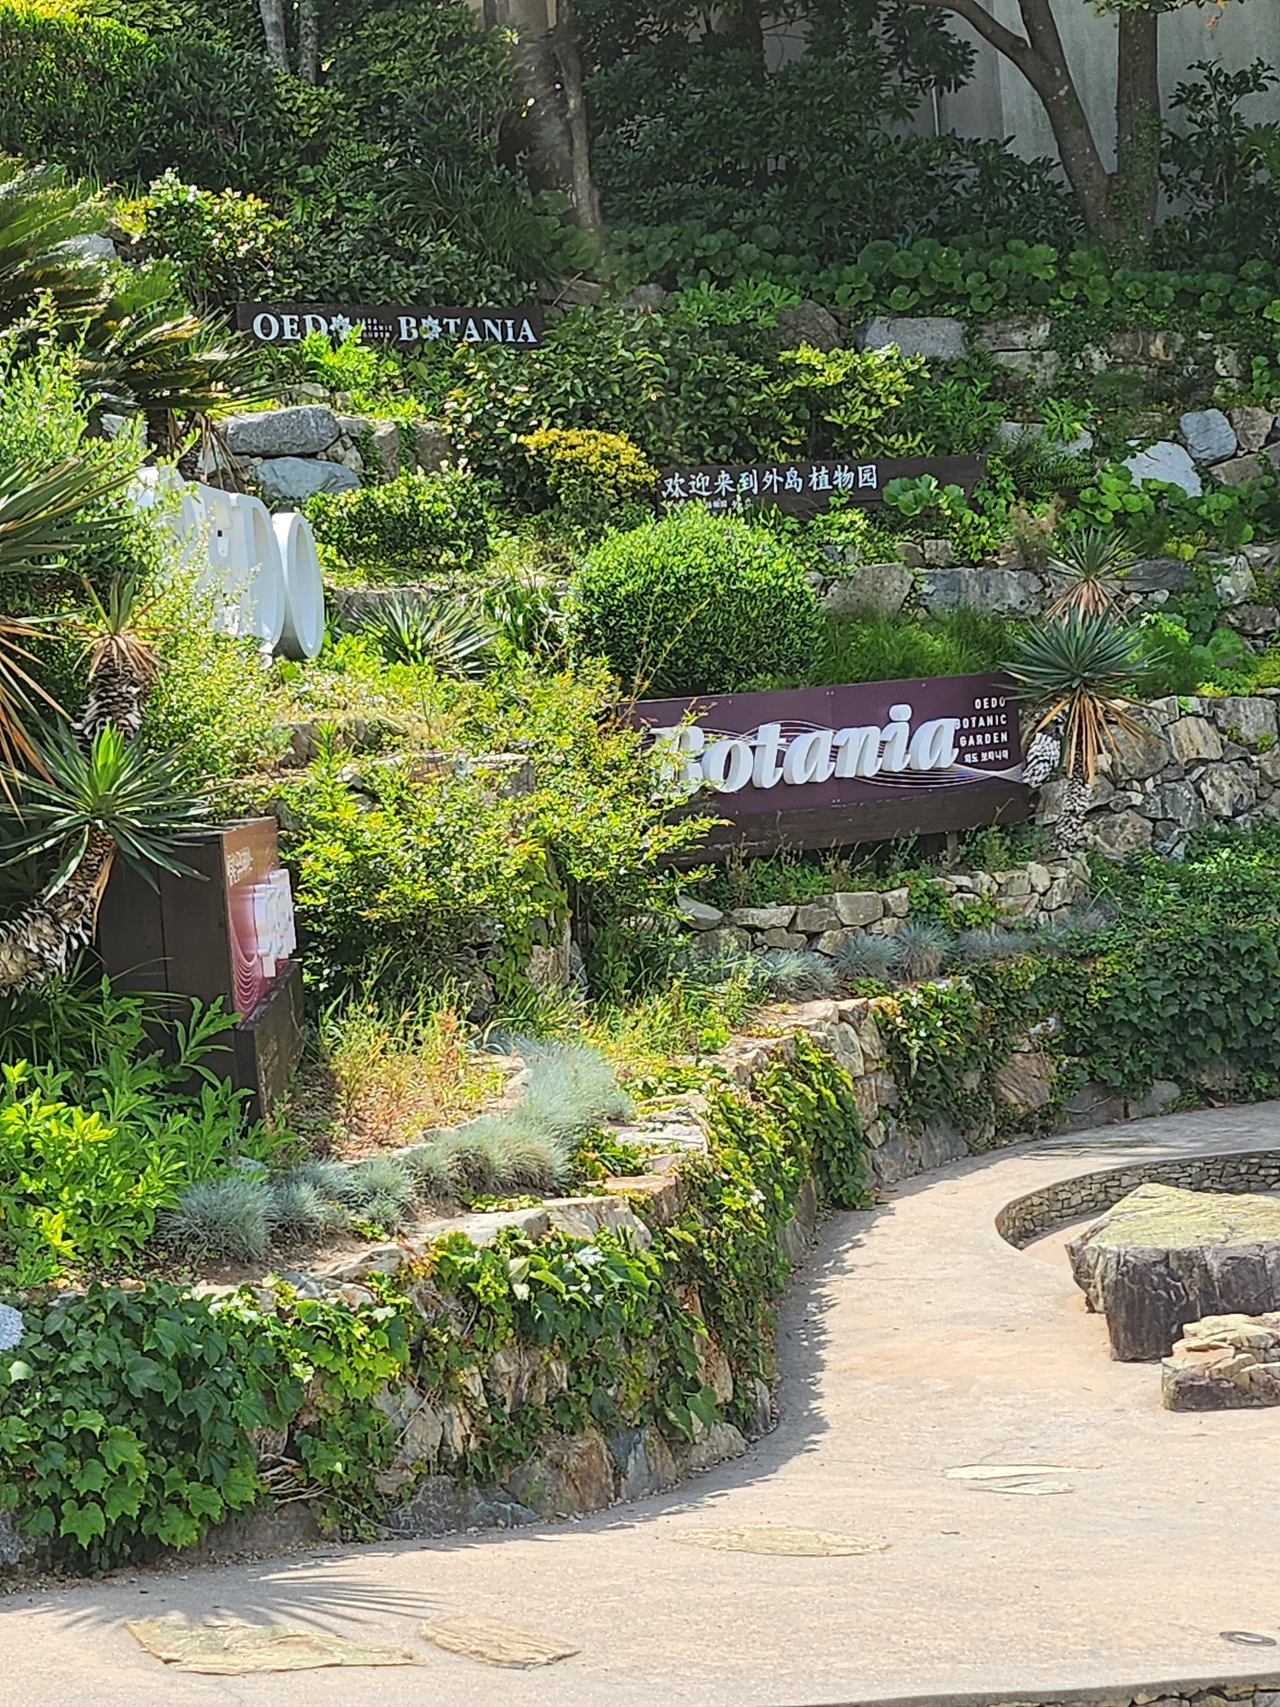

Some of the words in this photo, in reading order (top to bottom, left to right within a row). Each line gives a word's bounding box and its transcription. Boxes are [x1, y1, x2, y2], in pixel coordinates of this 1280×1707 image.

[974, 696, 1006, 709] OEDO
[960, 731, 1008, 747] GARDEN
[646, 703, 958, 798] Botania
